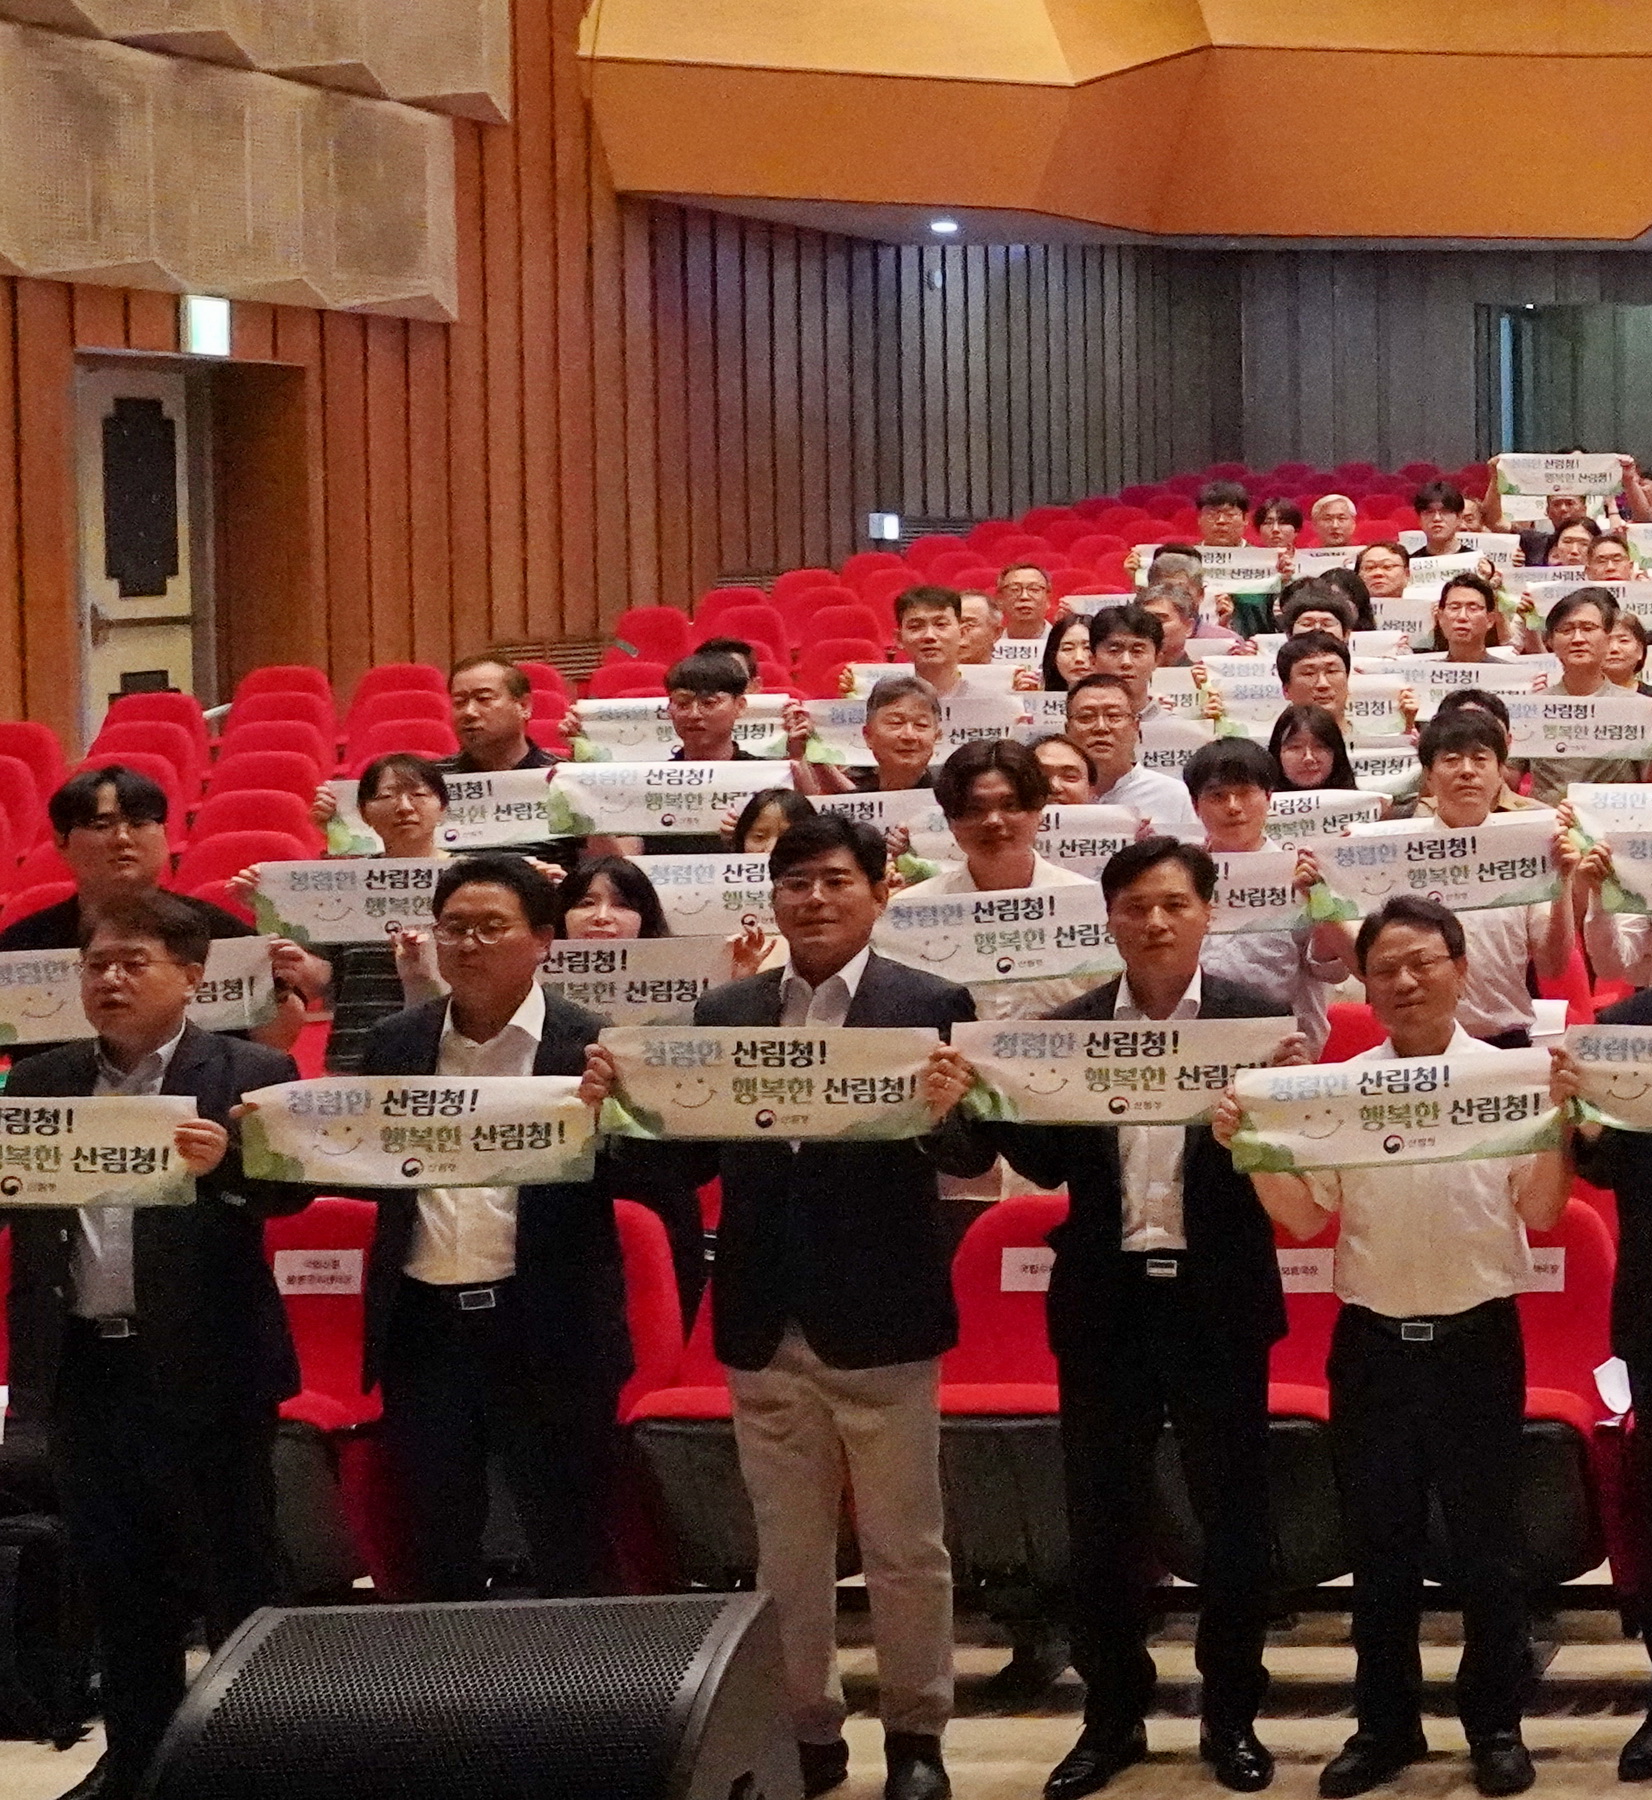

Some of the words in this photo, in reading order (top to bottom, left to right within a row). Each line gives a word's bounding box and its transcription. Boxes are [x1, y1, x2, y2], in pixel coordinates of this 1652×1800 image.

[1430, 670, 1479, 684] 산림청!
[1543, 703, 1595, 719] 산림청!
[1593, 724, 1645, 740] 산림청!
[644, 768, 713, 786] 산림청!
[1404, 836, 1476, 860] 산림청!
[1477, 857, 1546, 882] 산림청!
[972, 896, 1055, 923] 산림청!
[1226, 888, 1295, 907] 산림청!
[974, 932, 1046, 953] 행복한
[732, 1040, 826, 1068] 산림청!
[1083, 1030, 1180, 1058] 산림청!
[732, 1077, 813, 1103] 행복한
[824, 1075, 917, 1102] 산림청!
[1085, 1066, 1166, 1092] 행복한
[1174, 1061, 1268, 1090] 산림
[1358, 1066, 1450, 1097] 산림청!
[381, 1089, 478, 1117] 산림청!
[1359, 1102, 1441, 1130] 행복한
[1447, 1093, 1539, 1126] 산림청!
[0, 1109, 74, 1133] 림청!
[380, 1128, 460, 1154] 행복한
[470, 1121, 566, 1149] 산림청!
[0, 1146, 61, 1171] 복한
[71, 1148, 169, 1174] 산림청!
